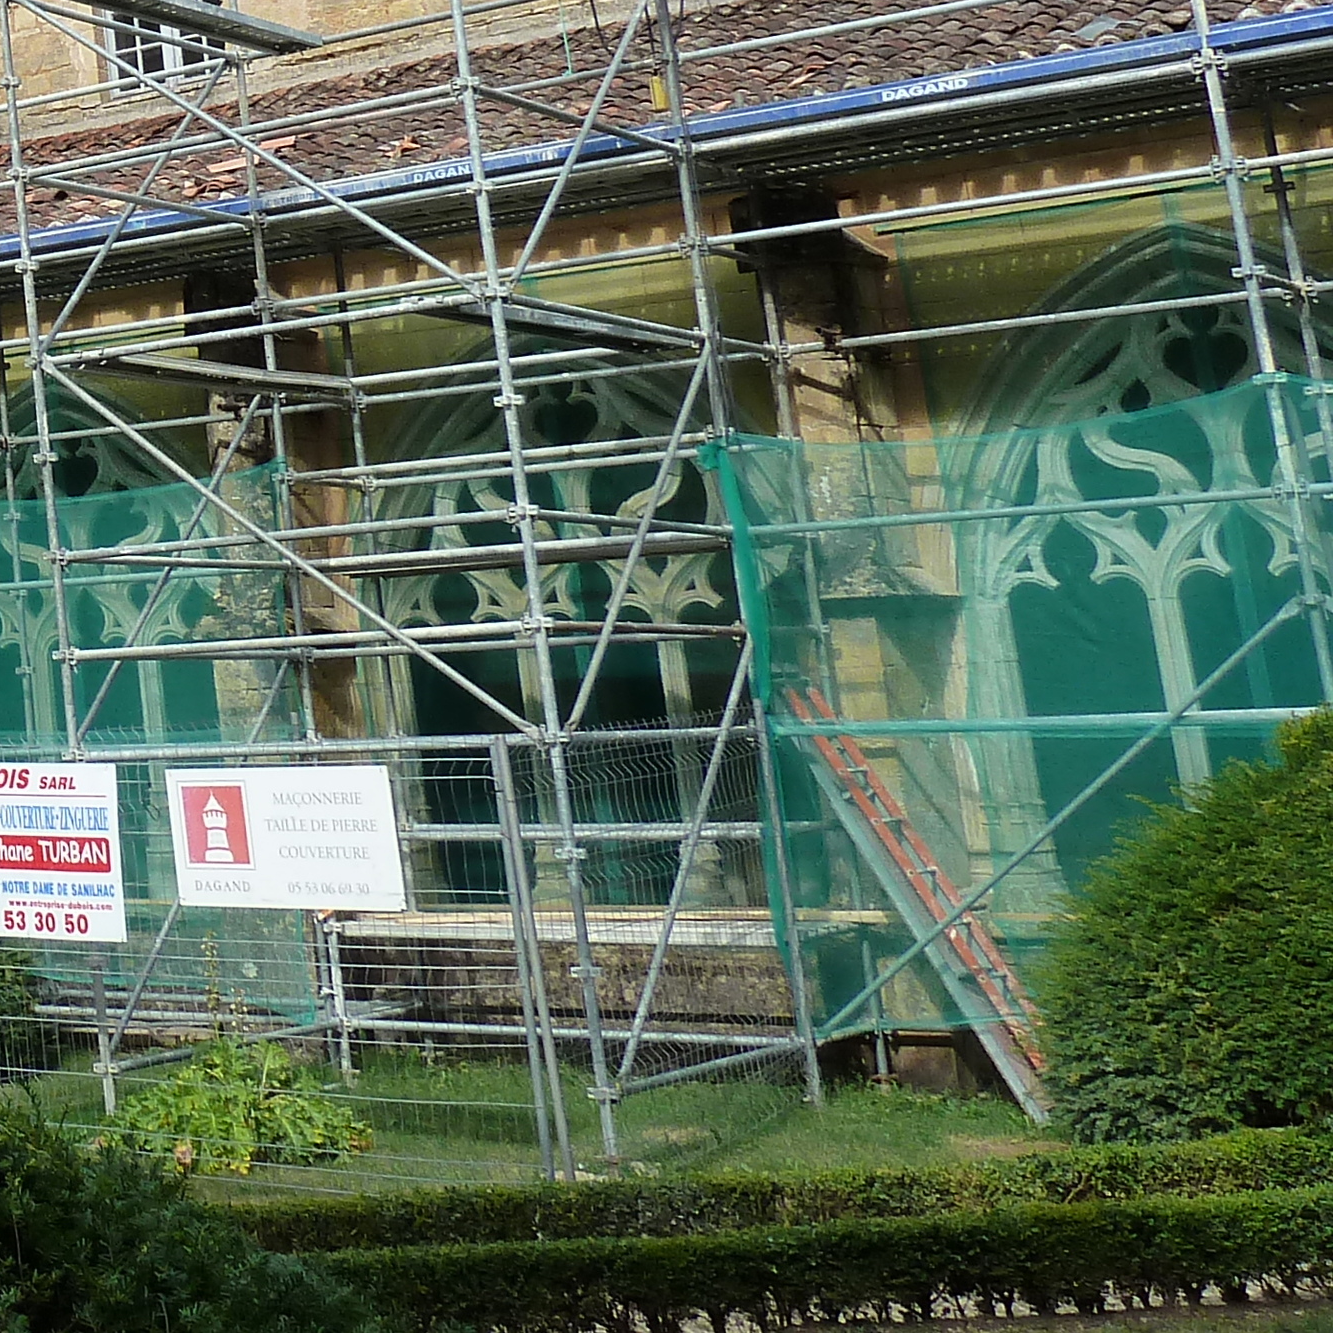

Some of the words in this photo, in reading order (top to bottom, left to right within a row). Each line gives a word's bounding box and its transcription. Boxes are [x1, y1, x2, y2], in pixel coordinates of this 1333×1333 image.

[881, 78, 969, 102] DAGAND
[39, 776, 77, 790] SARL
[272, 791, 364, 808] MAÇONNERIE
[264, 816, 308, 833] TAILLE
[310, 818, 329, 833] DE
[331, 818, 379, 834] PIERRE
[37, 839, 109, 865] TURBAN
[278, 845, 371, 860] COUVERTURE
[2, 880, 30, 895] NOTRE
[32, 881, 55, 896] DAME
[57, 882, 69, 896] DE
[72, 883, 115, 898] SANILHAC
[194, 879, 251, 893] DAGAND
[287, 881, 303, 895] 05
[304, 881, 319, 895] 53
[320, 881, 336, 896] 06
[355, 882, 371, 896] 30
[4, 910, 27, 931] 53
[34, 911, 56, 933] 30
[64, 912, 89, 934] 50
